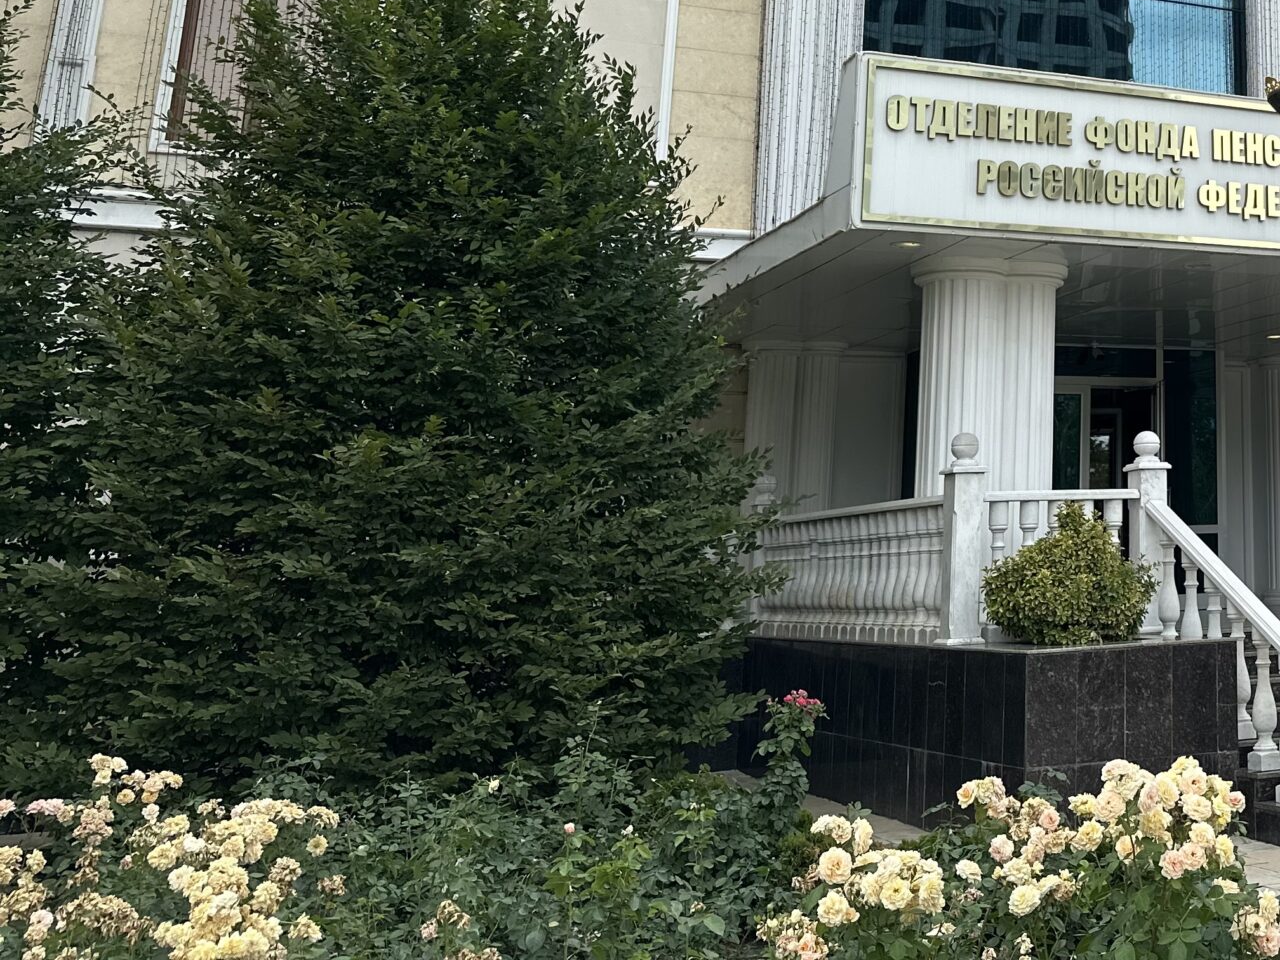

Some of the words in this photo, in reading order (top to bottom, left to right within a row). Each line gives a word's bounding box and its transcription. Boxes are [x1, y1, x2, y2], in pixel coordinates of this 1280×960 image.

[886, 95, 1073, 146] ОТДЕЛЕНИЕ
[1085, 115, 1199, 162] ФОНДА
[977, 159, 1186, 210] РОССИЙСКОЙ
